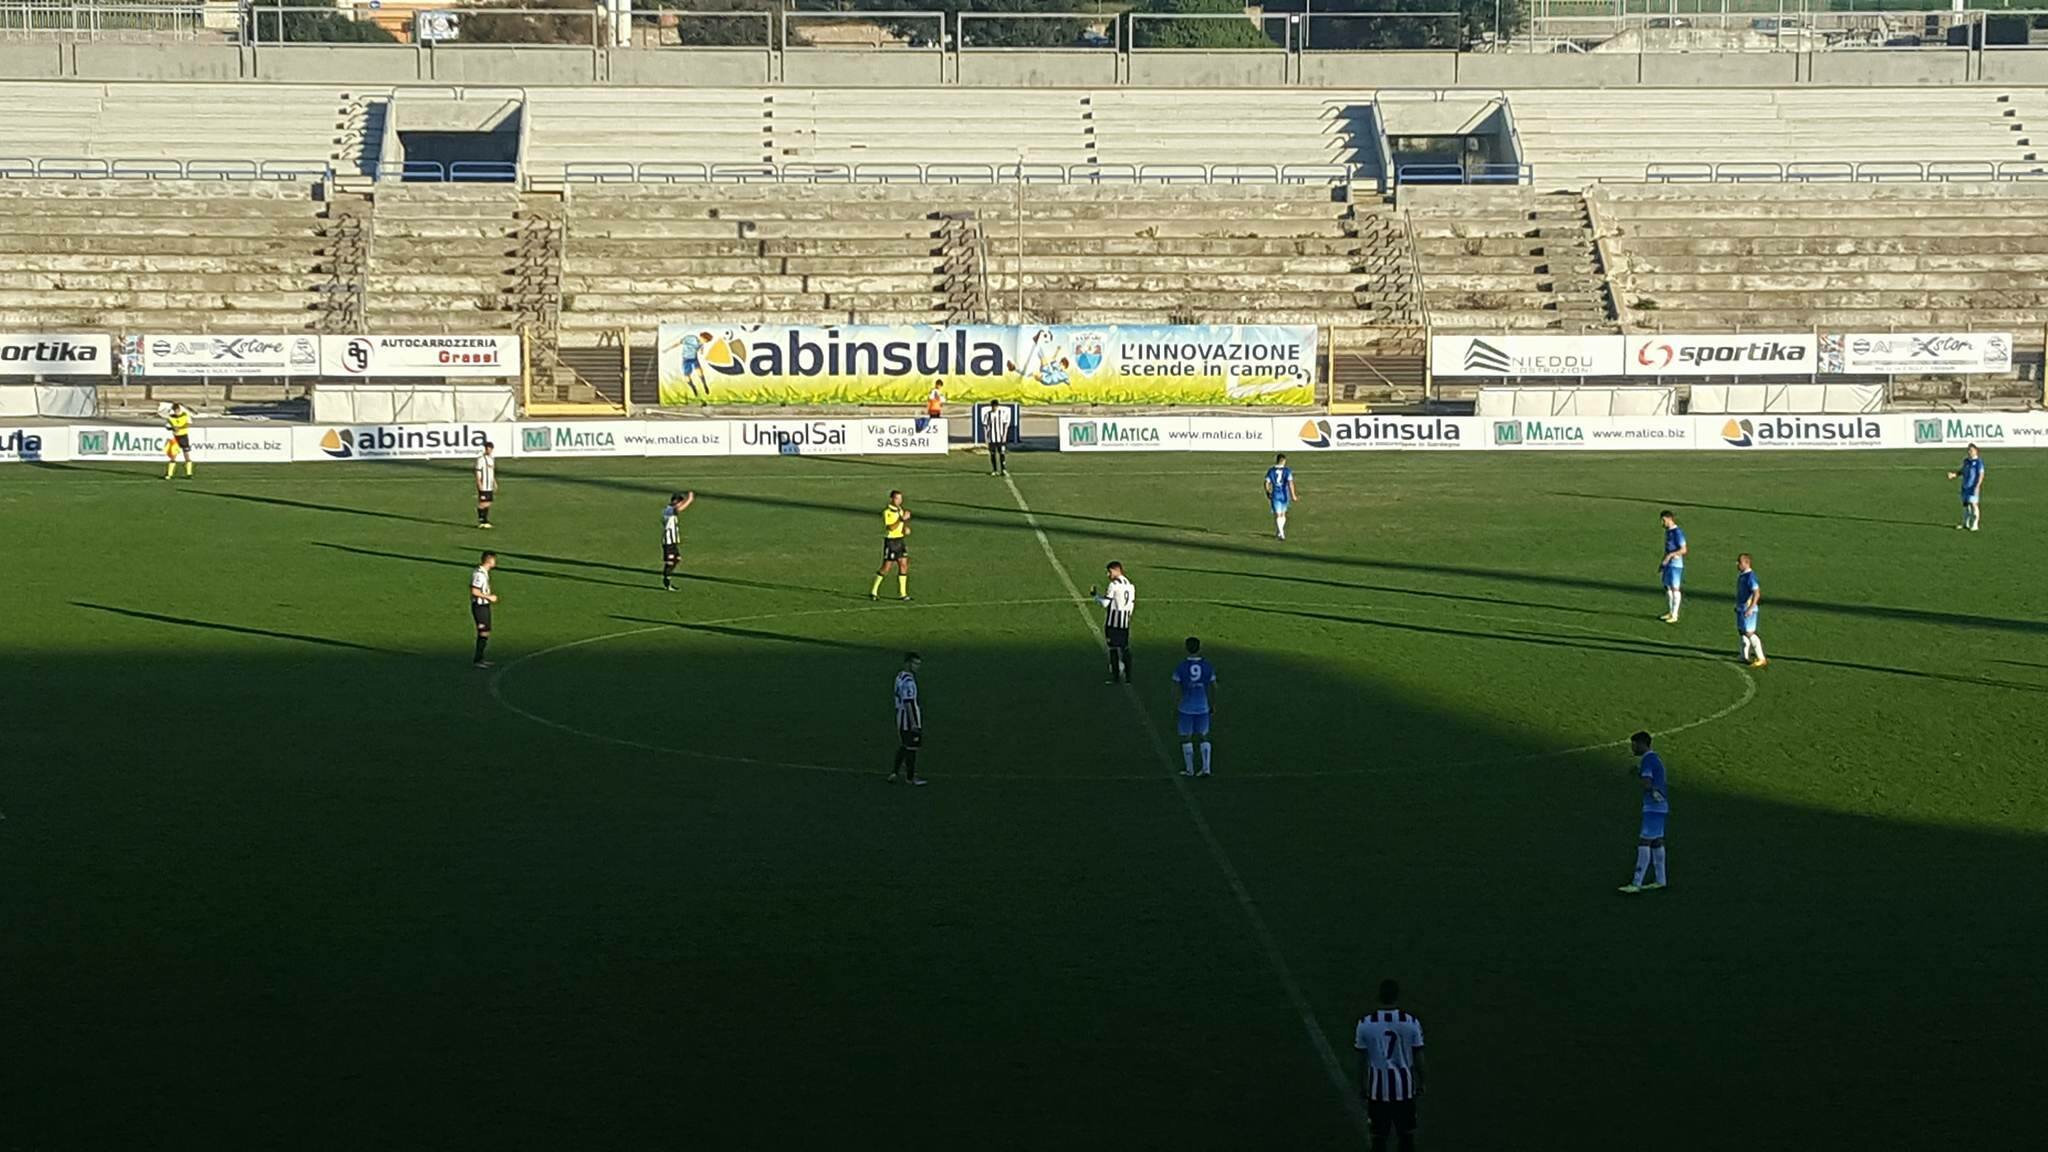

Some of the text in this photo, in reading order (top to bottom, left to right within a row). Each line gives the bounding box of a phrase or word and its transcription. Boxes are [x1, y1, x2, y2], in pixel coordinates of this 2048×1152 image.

[0, 341, 97, 361] ortika
[380, 339, 497, 347] AUTOCARROZZERIA
[1121, 343, 1300, 361] L'INNOVAZIONE
[749, 330, 1003, 377] abinsula
[1512, 356, 1593, 367] NIEDDU
[1679, 342, 1806, 366] sportika
[1120, 361, 1299, 379] scende in campo
[358, 424, 488, 449] abinsula
[556, 427, 615, 447] MATICA
[624, 434, 720, 445] www.matica.biz
[868, 425, 885, 434] Via
[889, 425, 915, 436] Giag
[1101, 422, 1160, 441] MATICA
[1168, 430, 1263, 440] www.matica.biz
[1336, 417, 1460, 440] abinsula
[1526, 421, 1584, 440] MATICA
[1592, 428, 1686, 438] www.matica.biz
[1758, 417, 1881, 439] abinsula
[1946, 419, 2004, 438] MATICA
[2012, 428, 2048, 436] www.
[112, 432, 166, 451] MATIC
[189, 440, 282, 450] ww.matica.biz
[742, 422, 846, 454] UnipolSai
[877, 438, 929, 447] SASSARI
[1189, 664, 1201, 681] 9
[1384, 1031, 1397, 1060] 7
